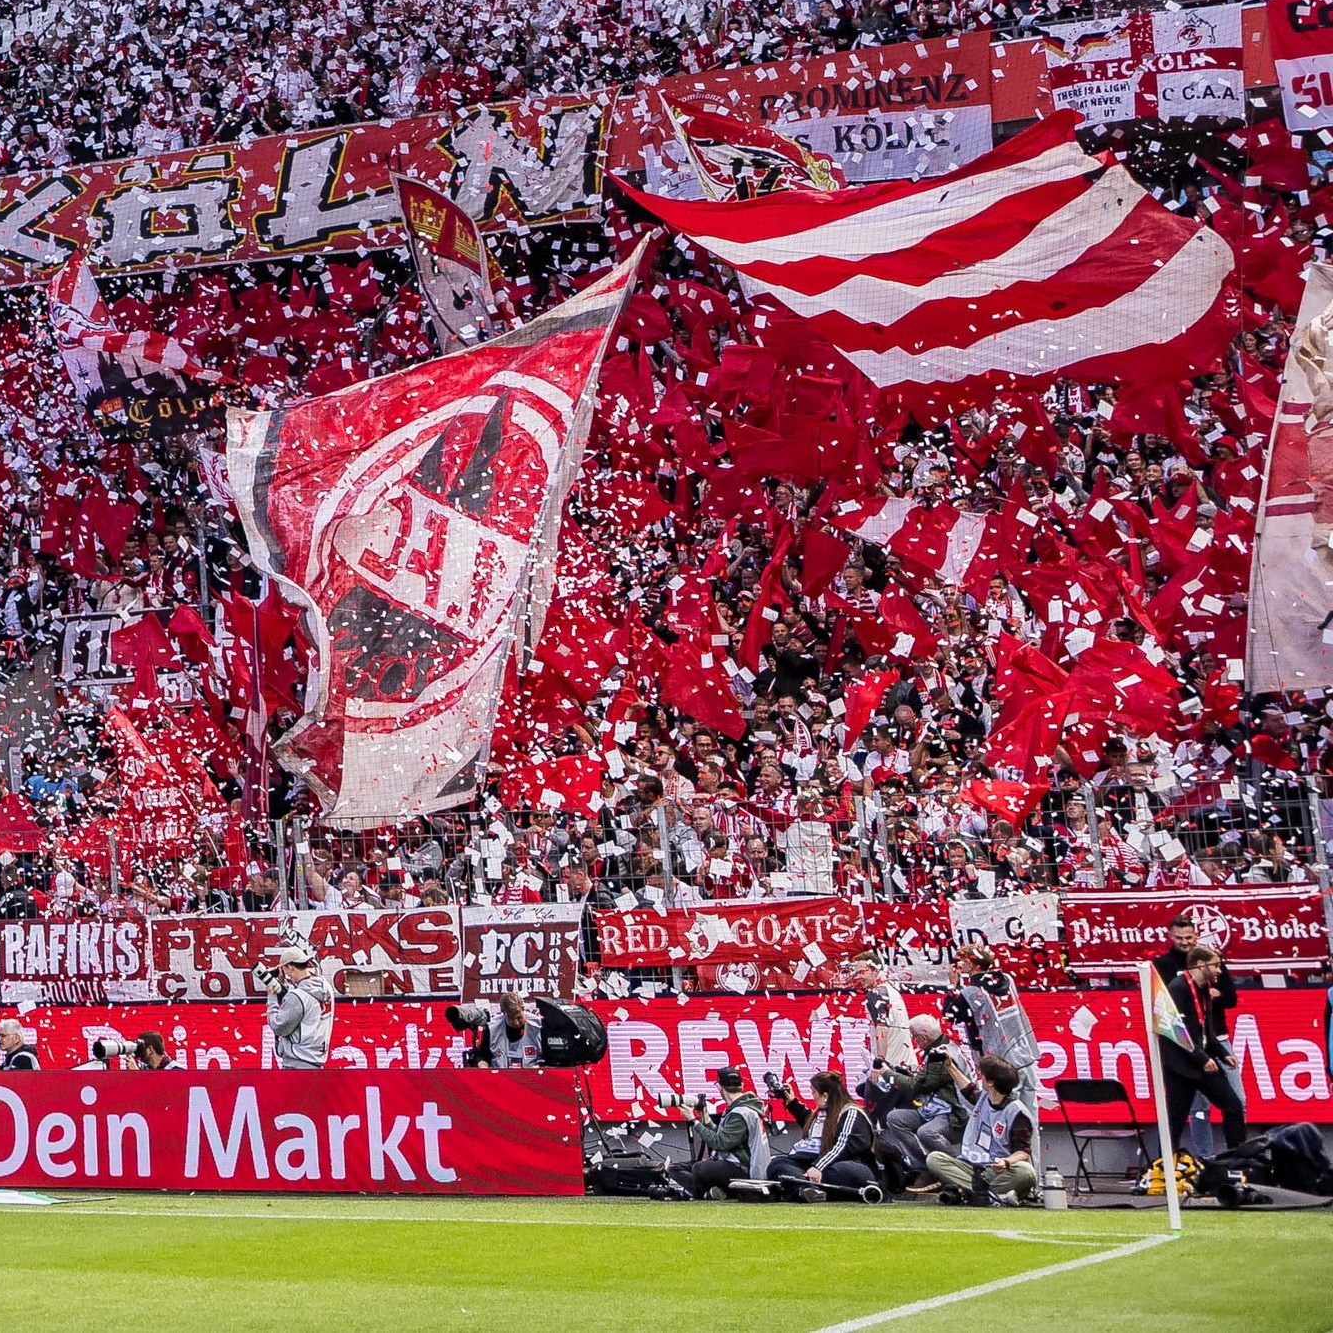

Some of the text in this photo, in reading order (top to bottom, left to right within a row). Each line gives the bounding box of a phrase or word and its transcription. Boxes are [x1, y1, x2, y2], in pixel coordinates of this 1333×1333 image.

[1108, 60, 1134, 78] FC
[1143, 52, 1206, 72] KÖLN
[759, 72, 969, 120] PROMINENZ
[1056, 87, 1083, 102] THERE
[1090, 96, 1122, 107] NEVER
[3, 922, 140, 975] RAFIKIS
[152, 910, 461, 969] FREAKS
[479, 931, 545, 976] FC
[600, 923, 669, 955] RED
[733, 913, 855, 949] GOATS
[184, 1085, 458, 1182] Markt
